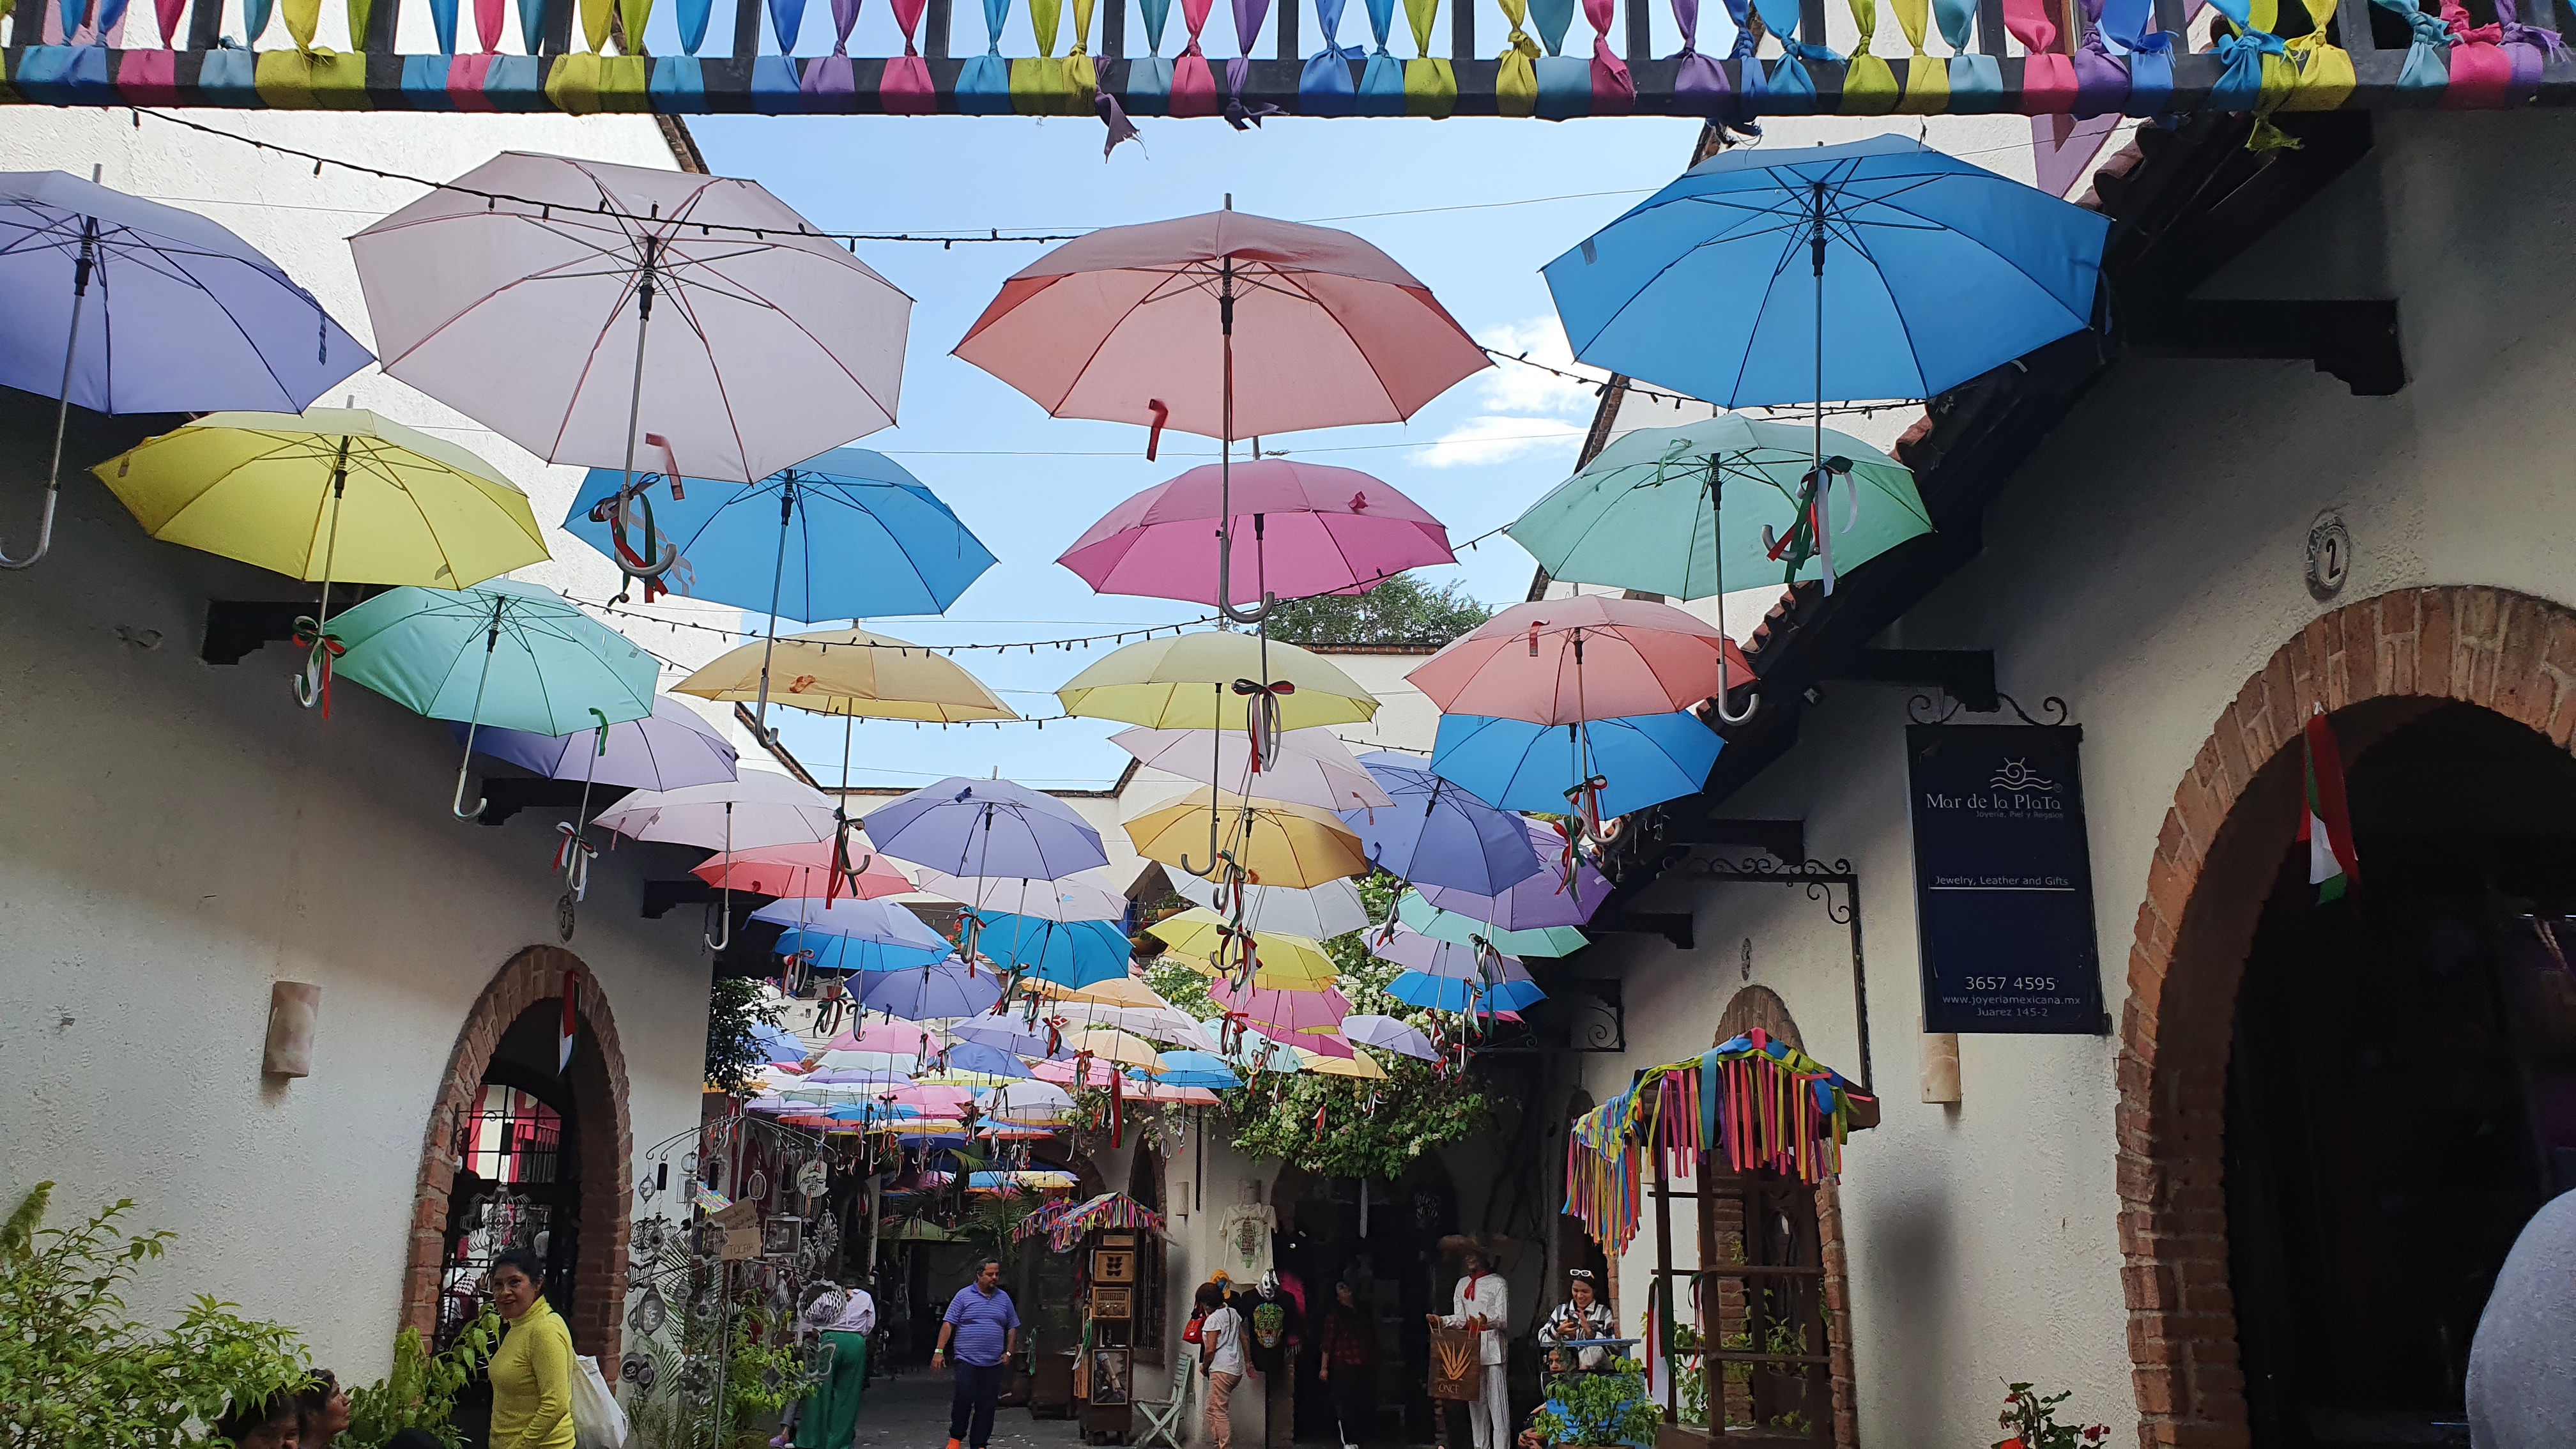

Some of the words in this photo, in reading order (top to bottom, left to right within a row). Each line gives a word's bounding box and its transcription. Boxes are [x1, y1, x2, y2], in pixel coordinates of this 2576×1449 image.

[2326, 538, 2341, 579] 2
[1926, 793, 1961, 809] Mar
[1967, 793, 1987, 809] de
[1993, 793, 2009, 809] la
[2034, 811, 2064, 820] Regalos
[1935, 875, 1976, 886] Jewelry,
[1980, 876, 2019, 885] Leather
[2023, 876, 2041, 885] and
[2045, 877, 2069, 885] Gifts
[1965, 976, 2007, 990] 3657
[2013, 977, 2056, 991] 4595
[1942, 995, 2080, 1006] www.joyeriamexicana.mx
[1977, 1008, 2012, 1016] Juarez
[2016, 1008, 2048, 1017] 145-2
